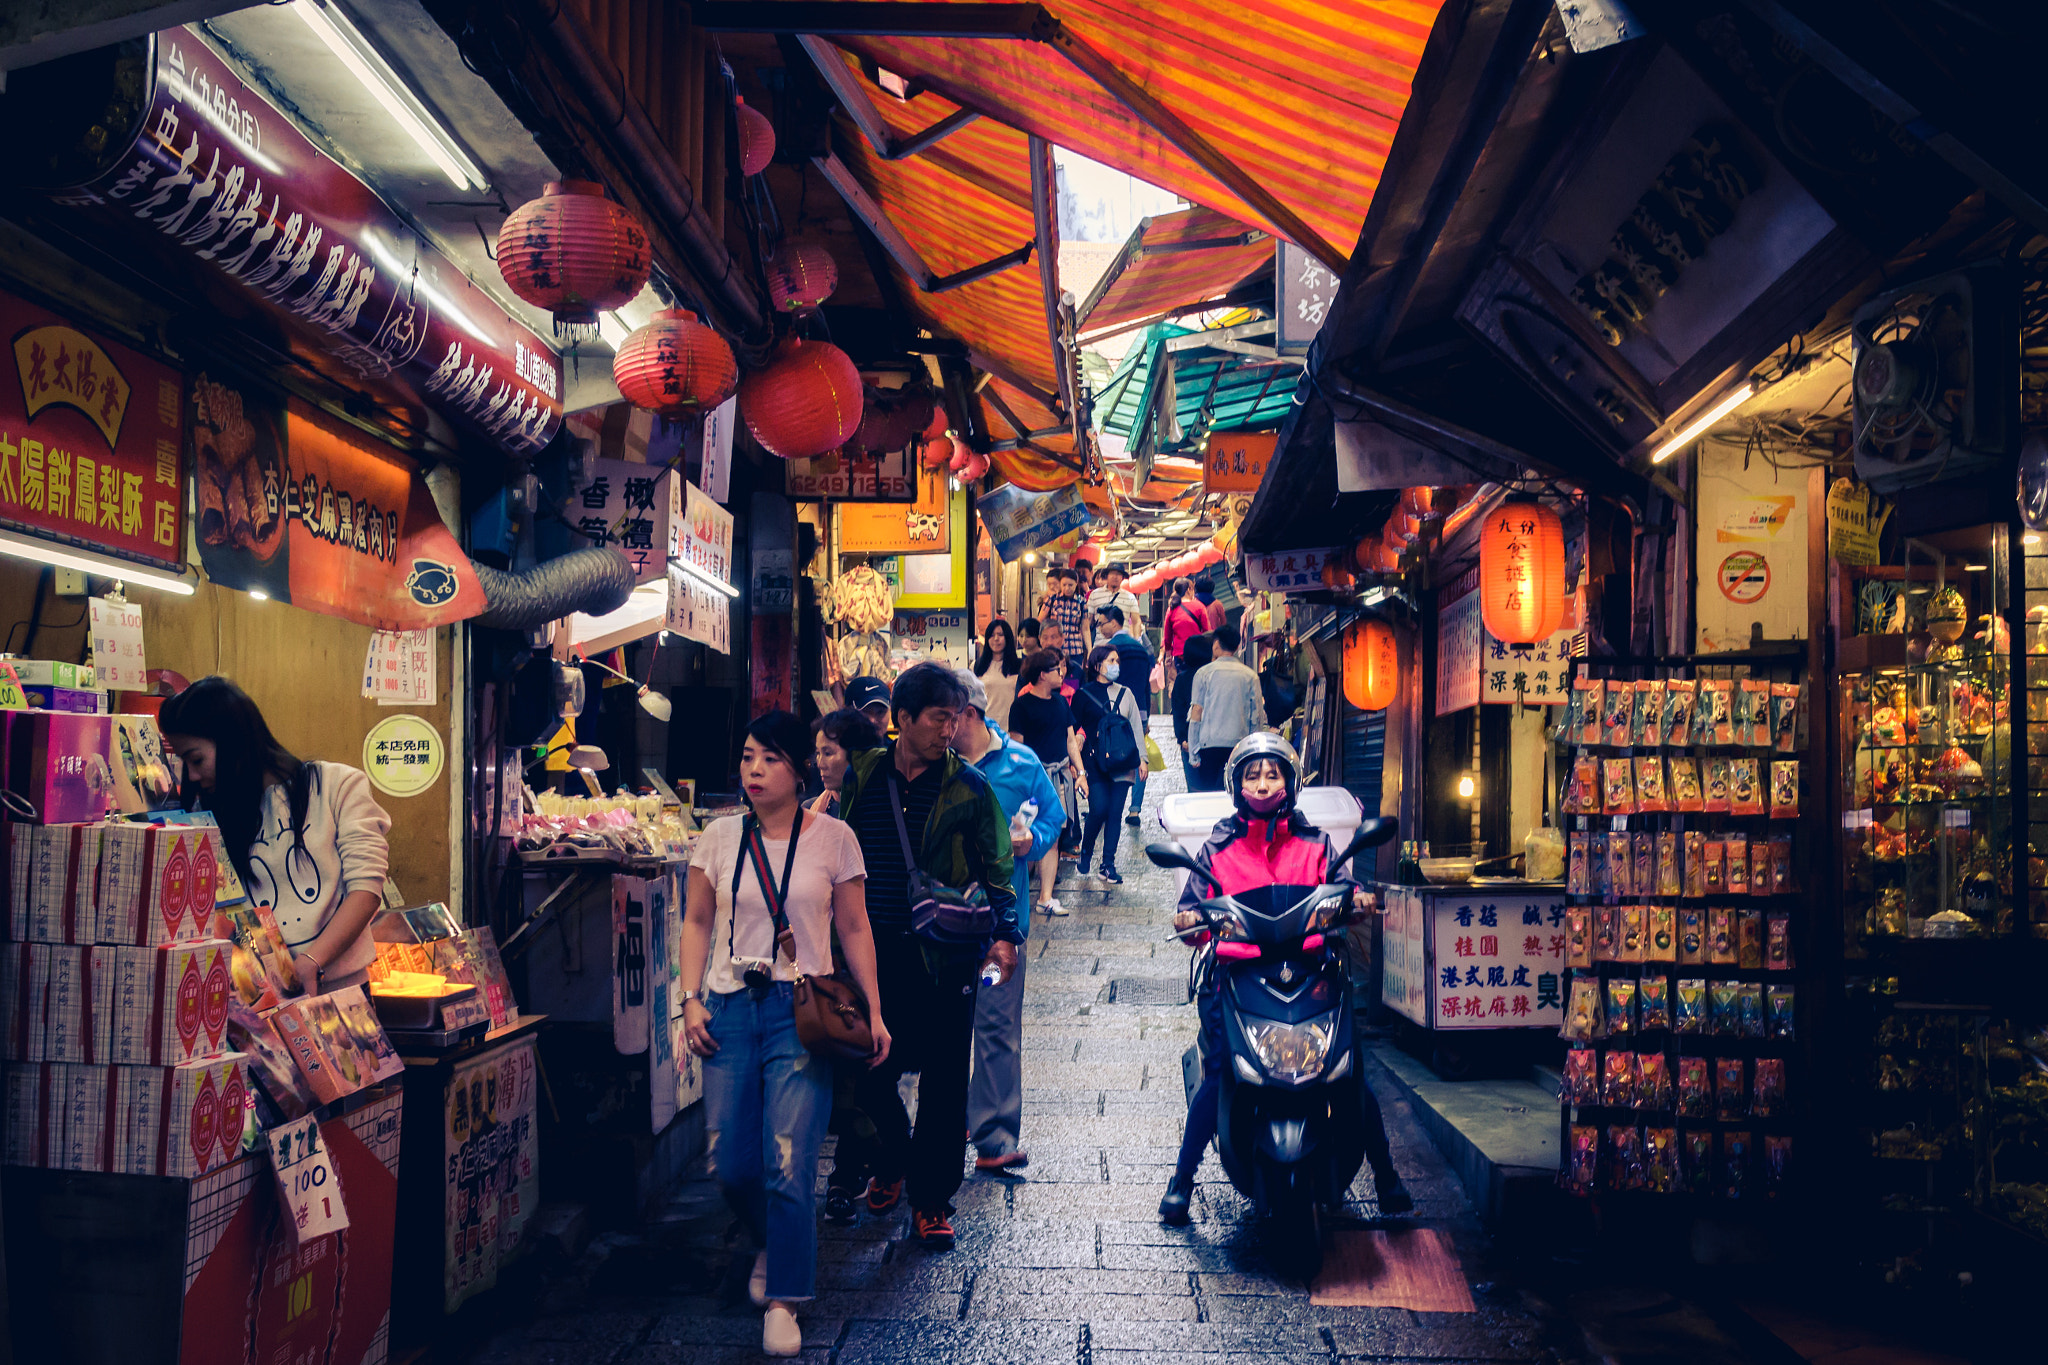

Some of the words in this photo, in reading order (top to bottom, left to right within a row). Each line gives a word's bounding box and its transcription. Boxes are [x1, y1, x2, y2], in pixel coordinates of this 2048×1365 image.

[191, 66, 261, 154] (九份分店)
[1297, 256, 1325, 326] 茶坊
[28, 340, 120, 428] 老太陽堂
[0, 431, 143, 537] 太陽餅鳳梨酥
[1498, 518, 1535, 536] 九份
[91, 606, 100, 622] 1
[121, 612, 142, 629] 100
[94, 638, 105, 654] 買
[109, 639, 117, 654] 3
[122, 643, 133, 657] 送
[137, 643, 144, 657] 1
[96, 667, 107, 682] 買
[111, 666, 118, 681] 5
[139, 670, 146, 685] 2
[403, 679, 409, 693] 元
[1490, 670, 1531, 694] 深坑
[376, 740, 430, 752] 本店免用
[376, 753, 430, 765] 統一發票
[1453, 903, 1498, 928] 香菇
[1455, 935, 1499, 958] 桂圓
[1440, 964, 1533, 989] 港式脆皮
[1441, 995, 1532, 1019] 深坑麻辣
